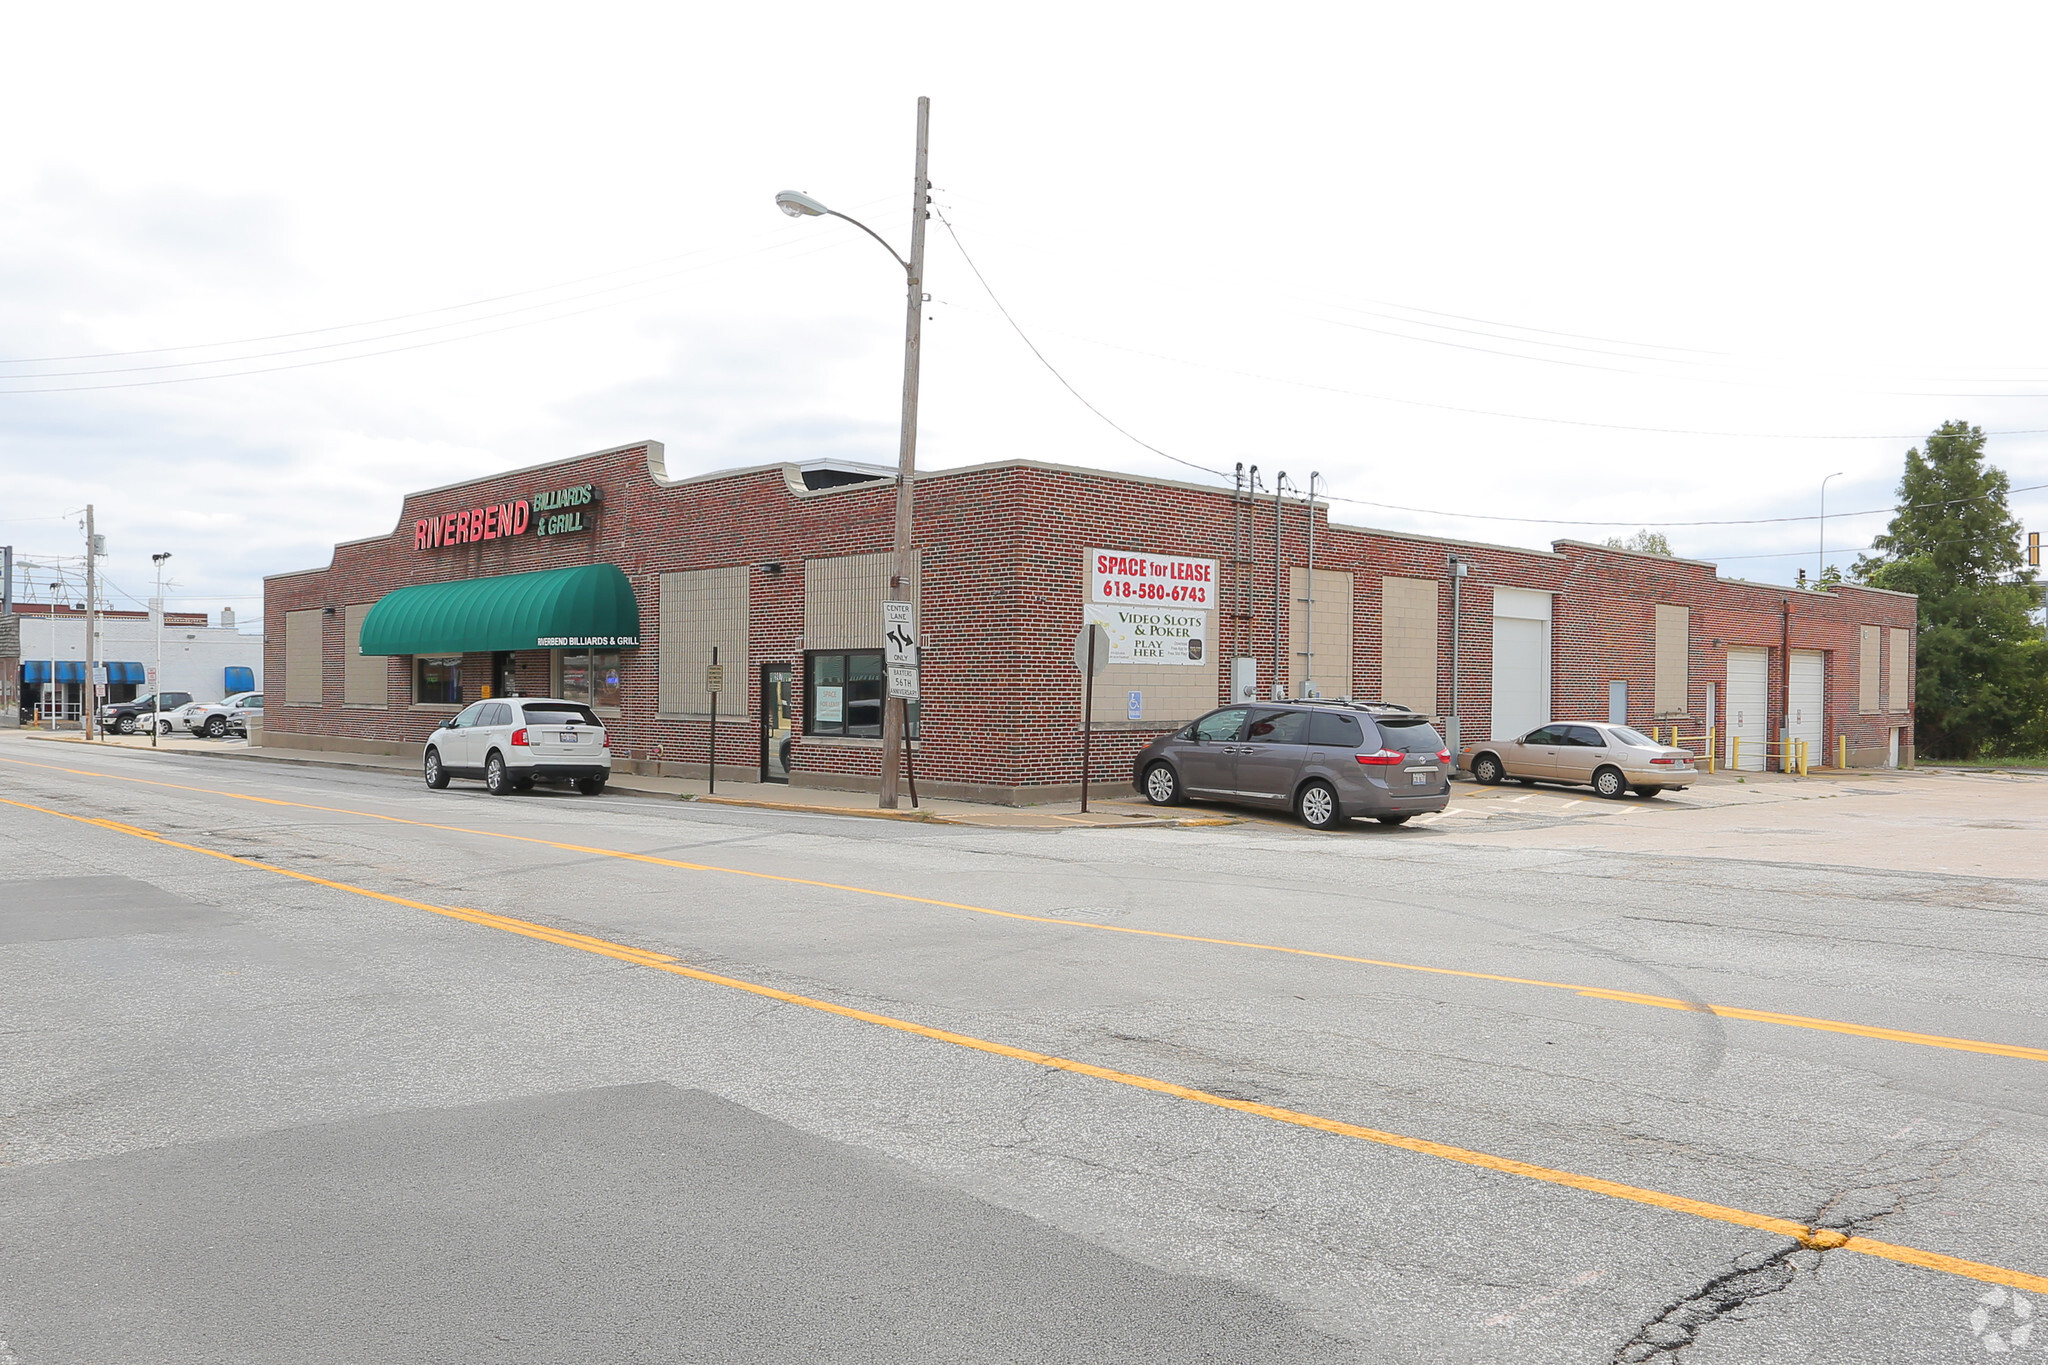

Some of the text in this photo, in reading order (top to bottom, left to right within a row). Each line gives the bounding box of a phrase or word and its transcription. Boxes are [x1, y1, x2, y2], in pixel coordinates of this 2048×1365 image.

[533, 484, 592, 513] BILLIARDS
[414, 500, 530, 551] RIVERBEND
[537, 512, 583, 537] & GRILL
[1097, 555, 1211, 582] SPACE for LEASE
[1103, 580, 1206, 603] 618-580-6743
[886, 604, 910, 613] CENTER
[890, 613, 907, 621] LANE
[1118, 611, 1202, 628] VIDEO SLOTS
[1134, 624, 1191, 638] & POKER
[537, 636, 640, 646] RIVERBEND BILLIARDS & GRILL
[1134, 640, 1163, 649] PLAY
[893, 653, 909, 662] ONLY
[1133, 649, 1165, 658] HERE
[895, 678, 912, 688] 56TH
